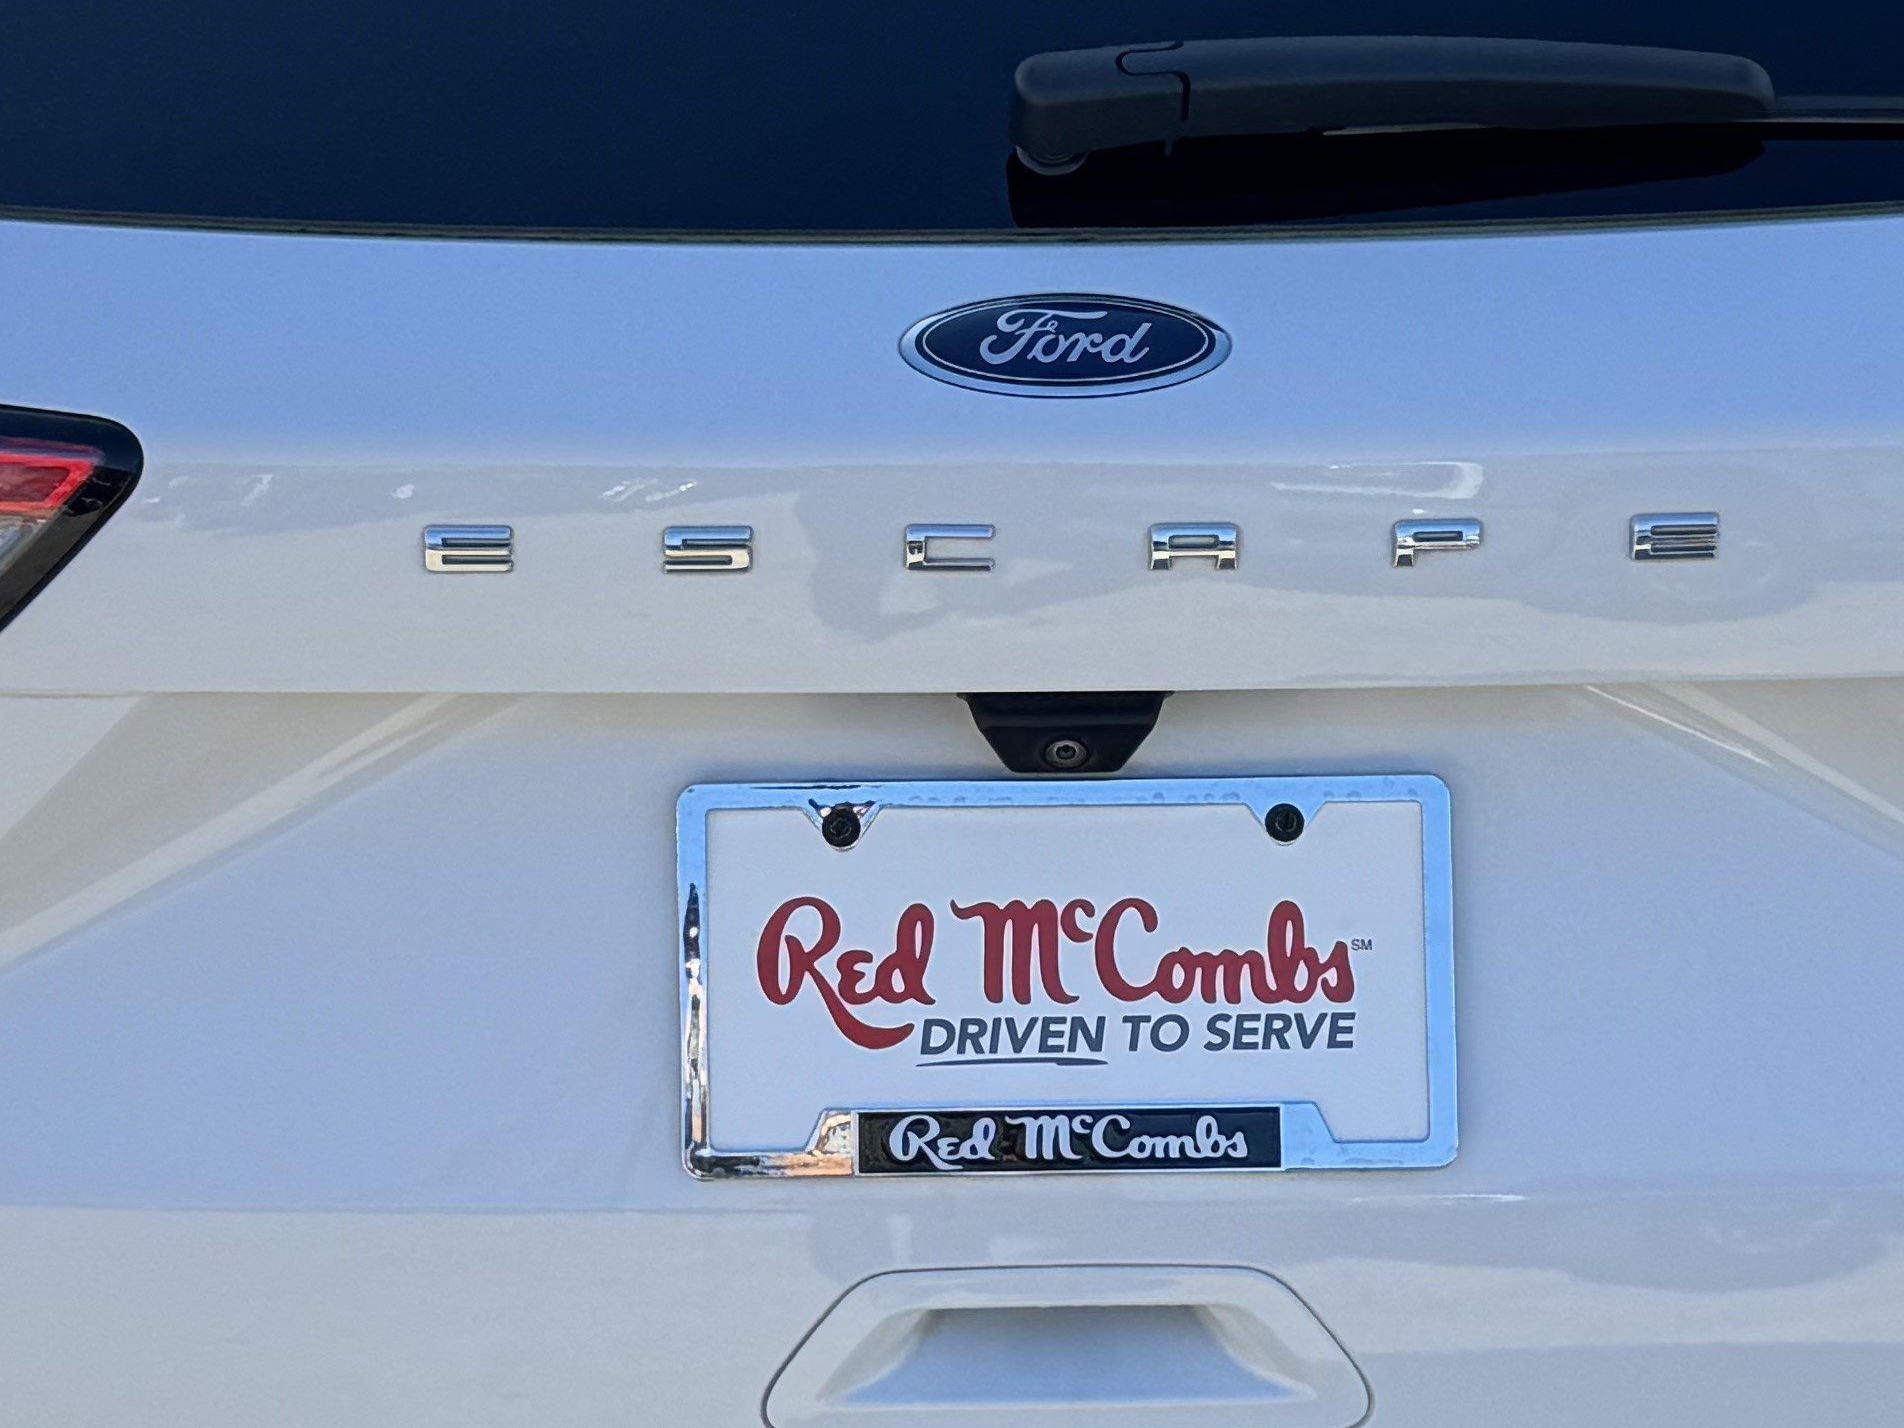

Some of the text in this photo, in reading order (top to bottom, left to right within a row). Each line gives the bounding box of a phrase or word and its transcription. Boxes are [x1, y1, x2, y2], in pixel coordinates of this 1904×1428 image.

[979, 308, 1153, 365] Ford
[422, 512, 1721, 573] ESCAPE
[756, 896, 937, 1049] Red
[950, 897, 1356, 1006] McCombs
[919, 1011, 1357, 1057] DRIVEN TO SERVE
[890, 1112, 1249, 1171] Red McCombs
